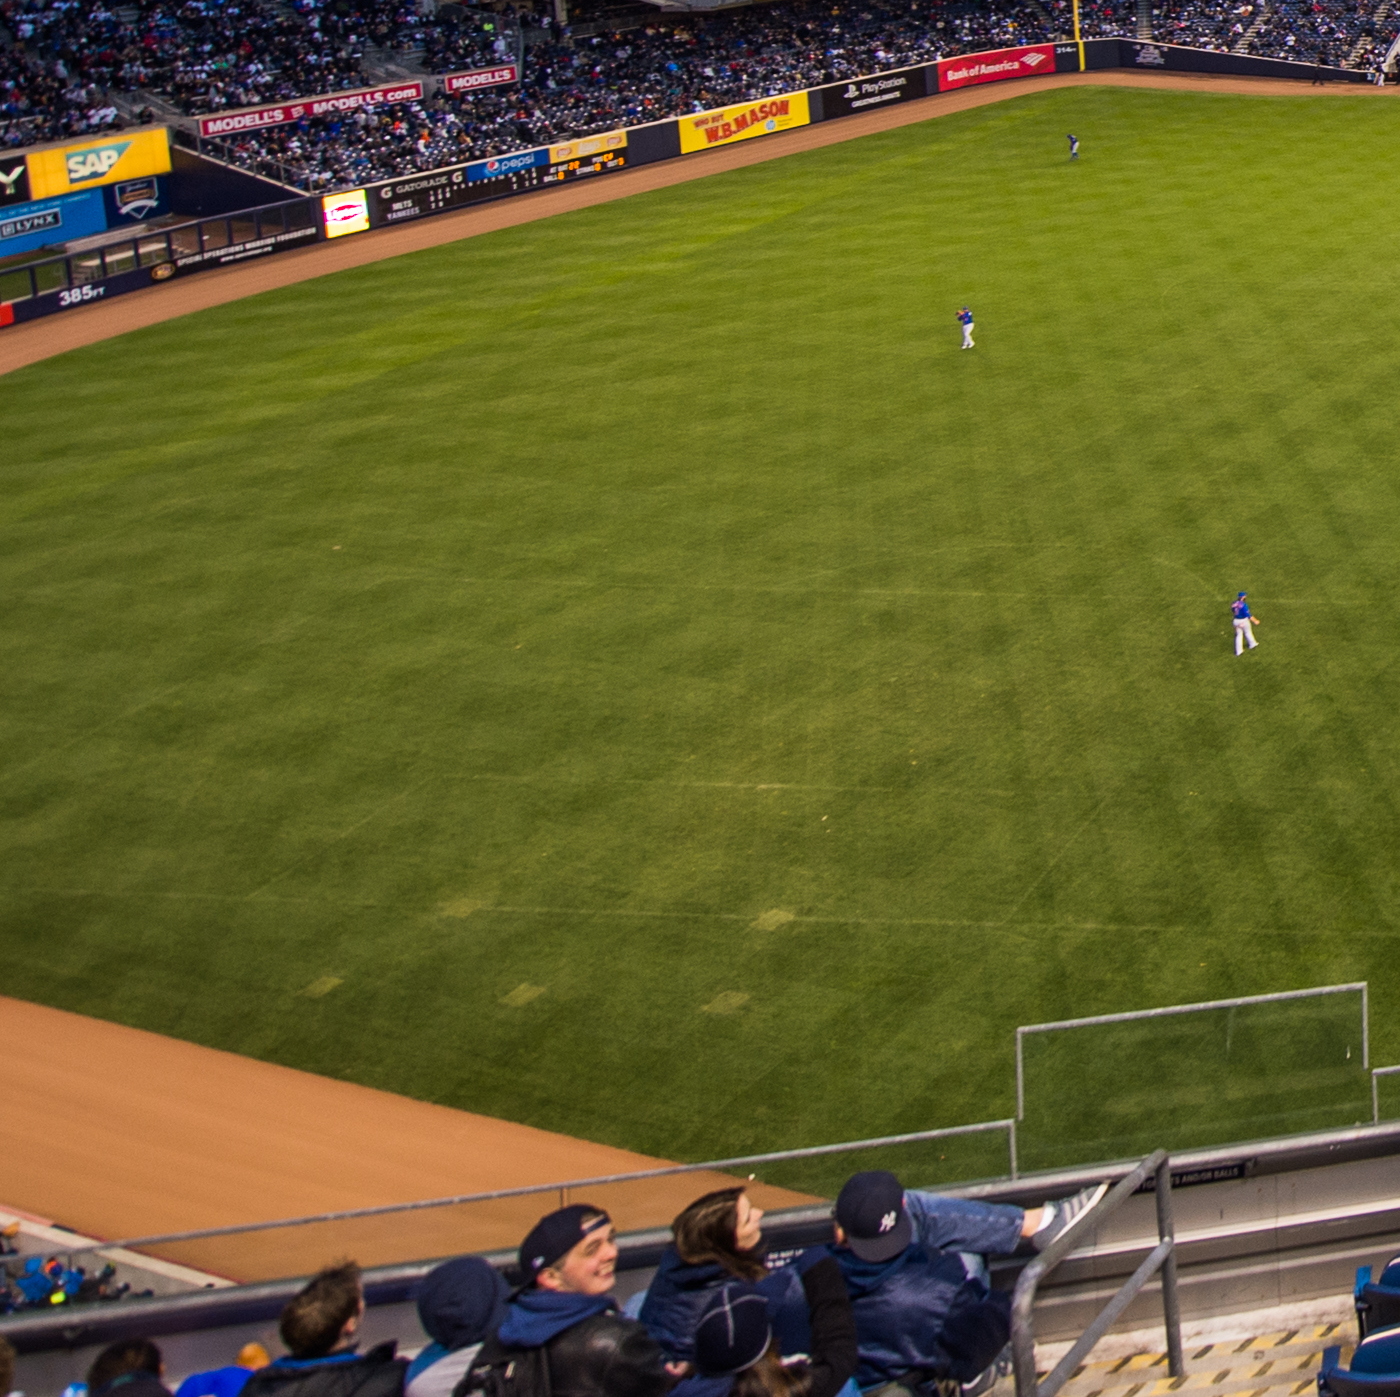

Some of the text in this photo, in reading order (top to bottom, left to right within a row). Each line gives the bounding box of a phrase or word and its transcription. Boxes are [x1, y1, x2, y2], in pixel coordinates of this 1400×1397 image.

[451, 69, 512, 90] MODELL'S
[947, 60, 1019, 81] Bank of America
[861, 76, 906, 94] PlayStation
[207, 109, 285, 134] MODELL'S
[67, 149, 119, 179] SAP
[501, 153, 535, 171] pepsi
[395, 175, 448, 194] GATORADE
